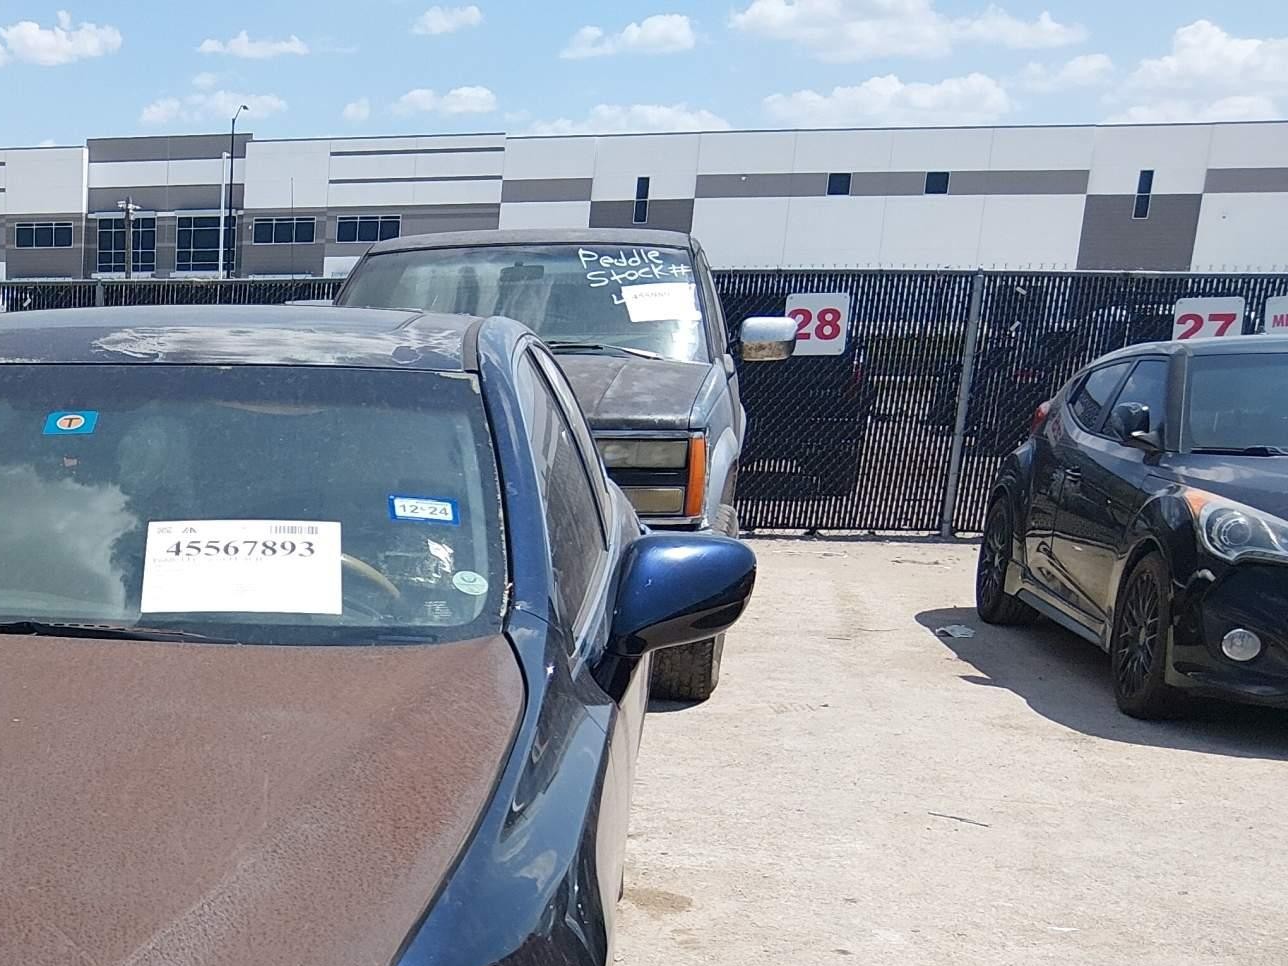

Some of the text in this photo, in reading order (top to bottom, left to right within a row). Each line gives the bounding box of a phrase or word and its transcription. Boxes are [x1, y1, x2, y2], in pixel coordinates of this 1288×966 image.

[578, 247, 664, 269] Peddle
[788, 308, 841, 341] 28
[1176, 313, 1237, 340] 27
[165, 540, 316, 557] 45567893
